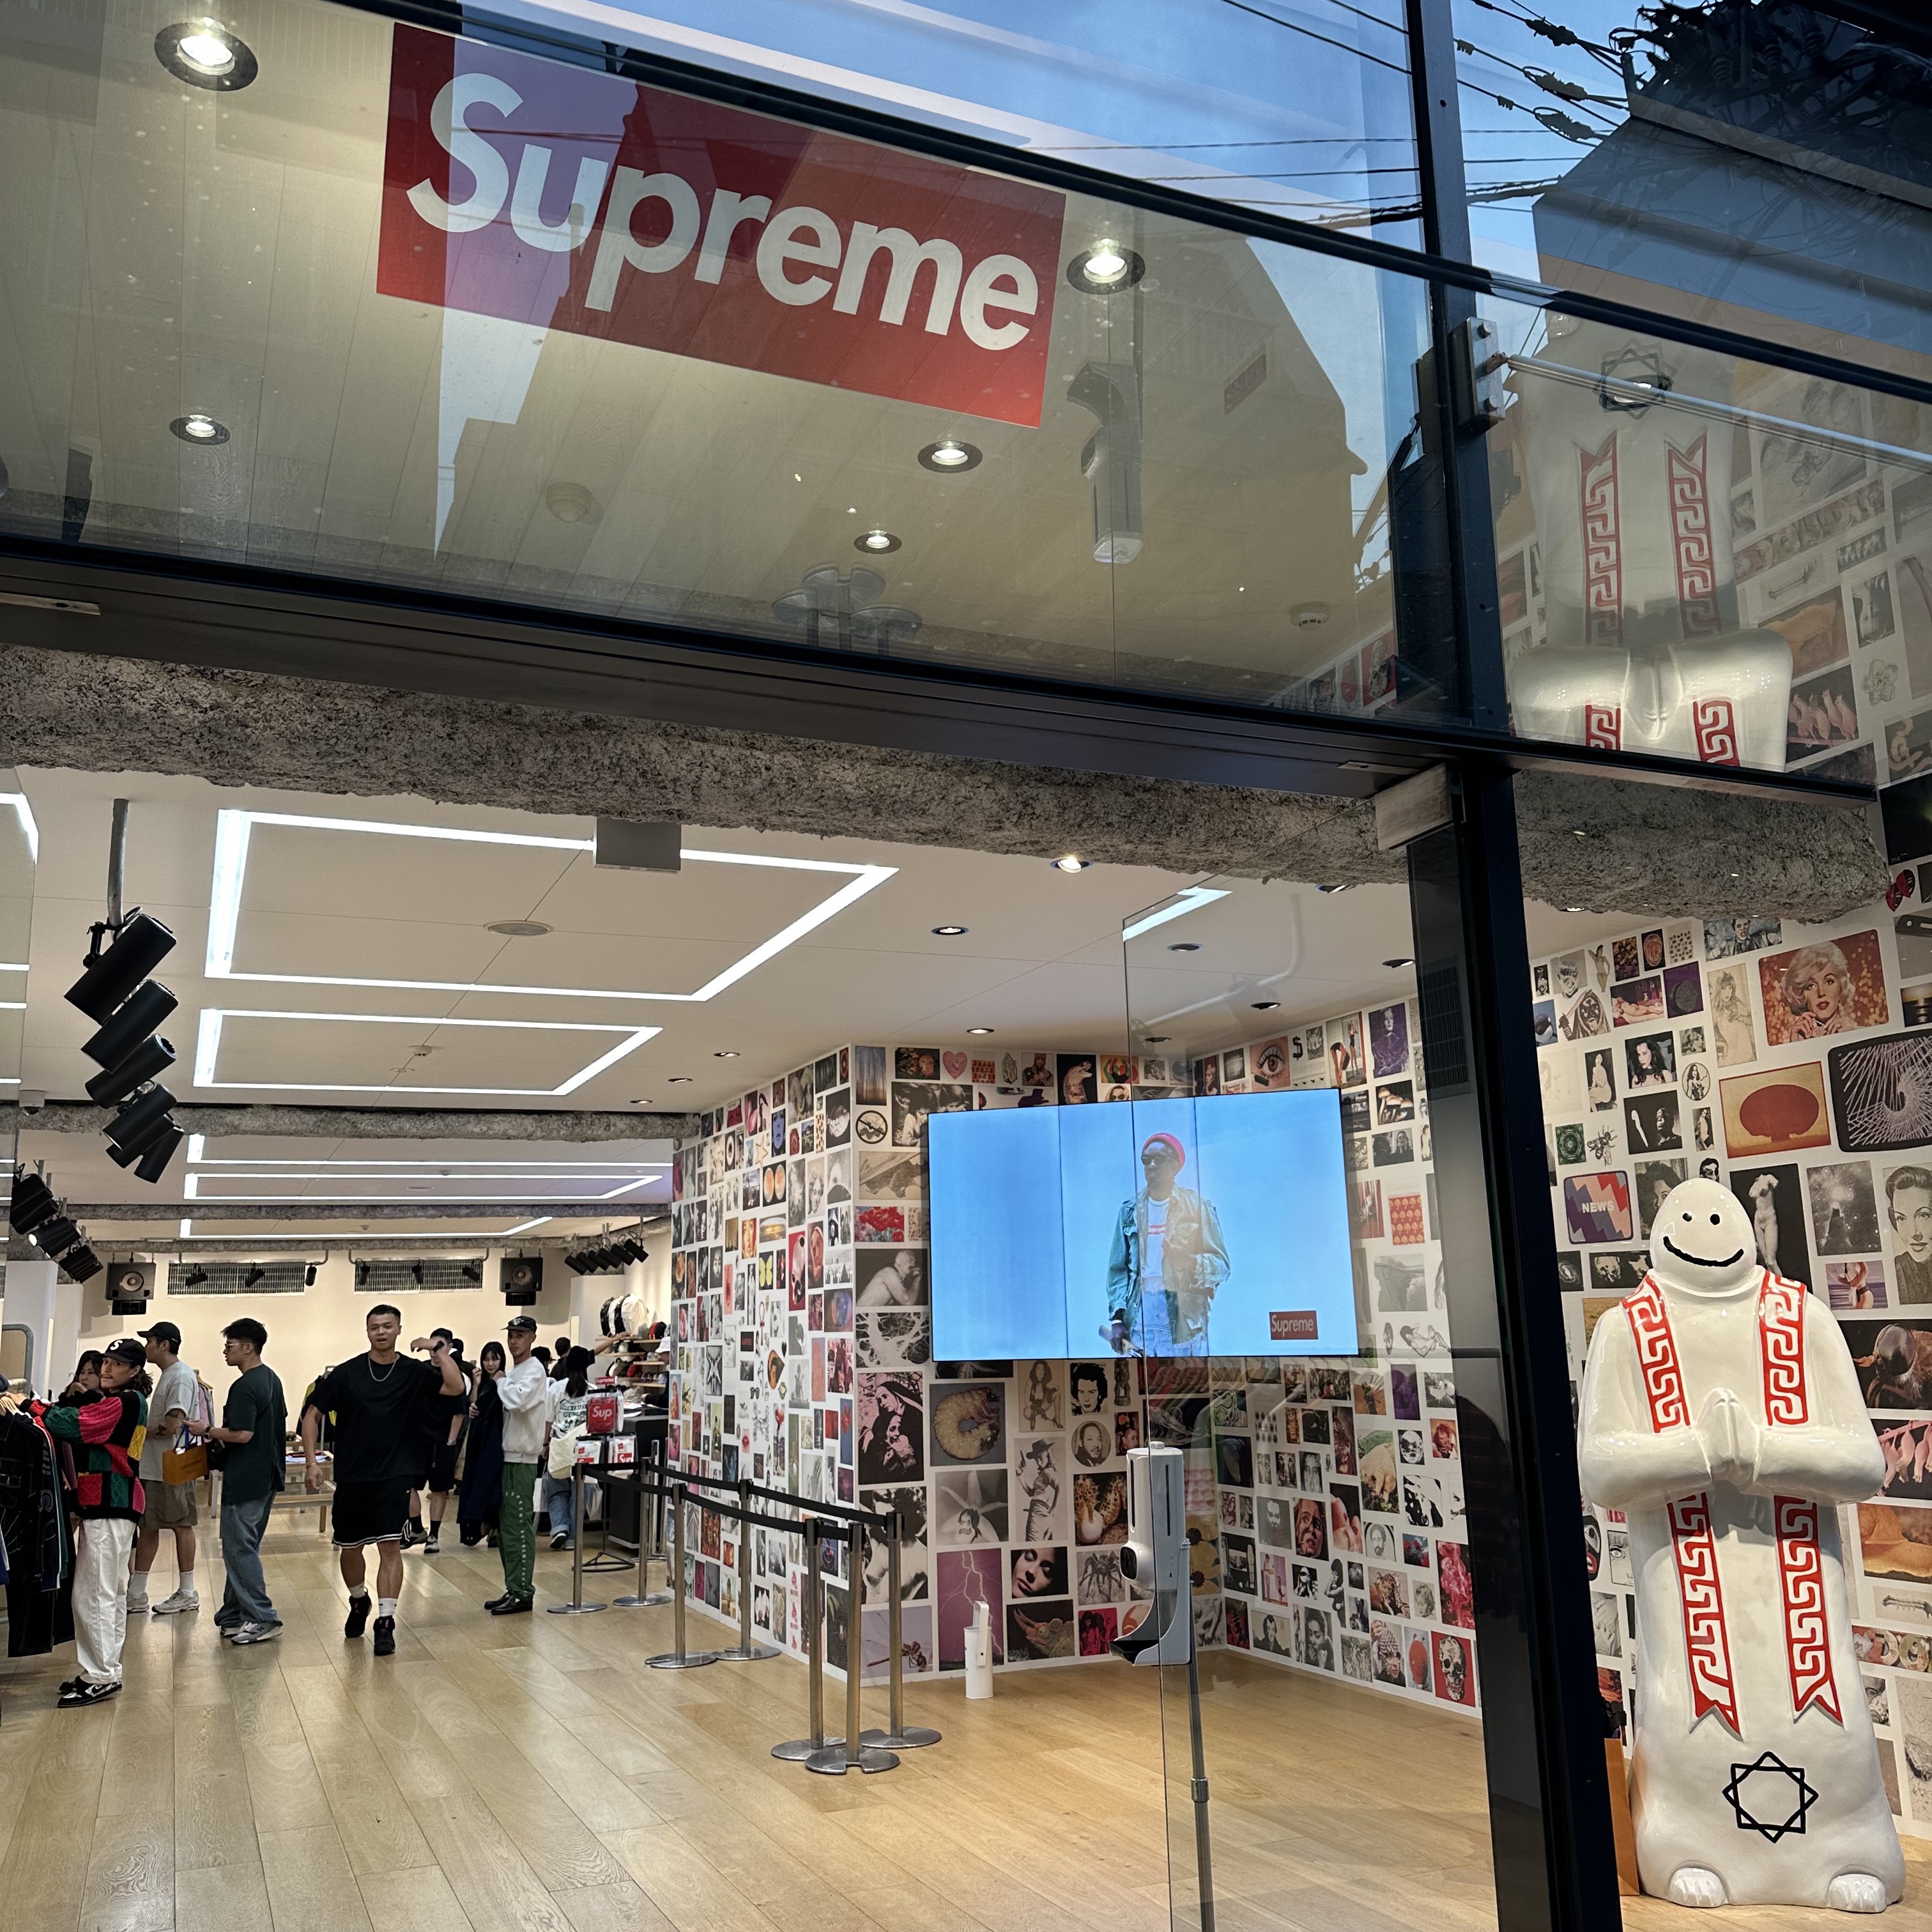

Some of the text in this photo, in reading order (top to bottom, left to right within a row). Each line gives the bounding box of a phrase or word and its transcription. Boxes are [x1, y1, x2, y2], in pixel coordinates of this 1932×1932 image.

[406, 73, 1039, 351] Supreme
[1582, 1200, 1614, 1213] NEWS
[1271, 1314, 1314, 1337] Supreme
[111, 1340, 123, 1351] S
[592, 1406, 613, 1420] Sup
